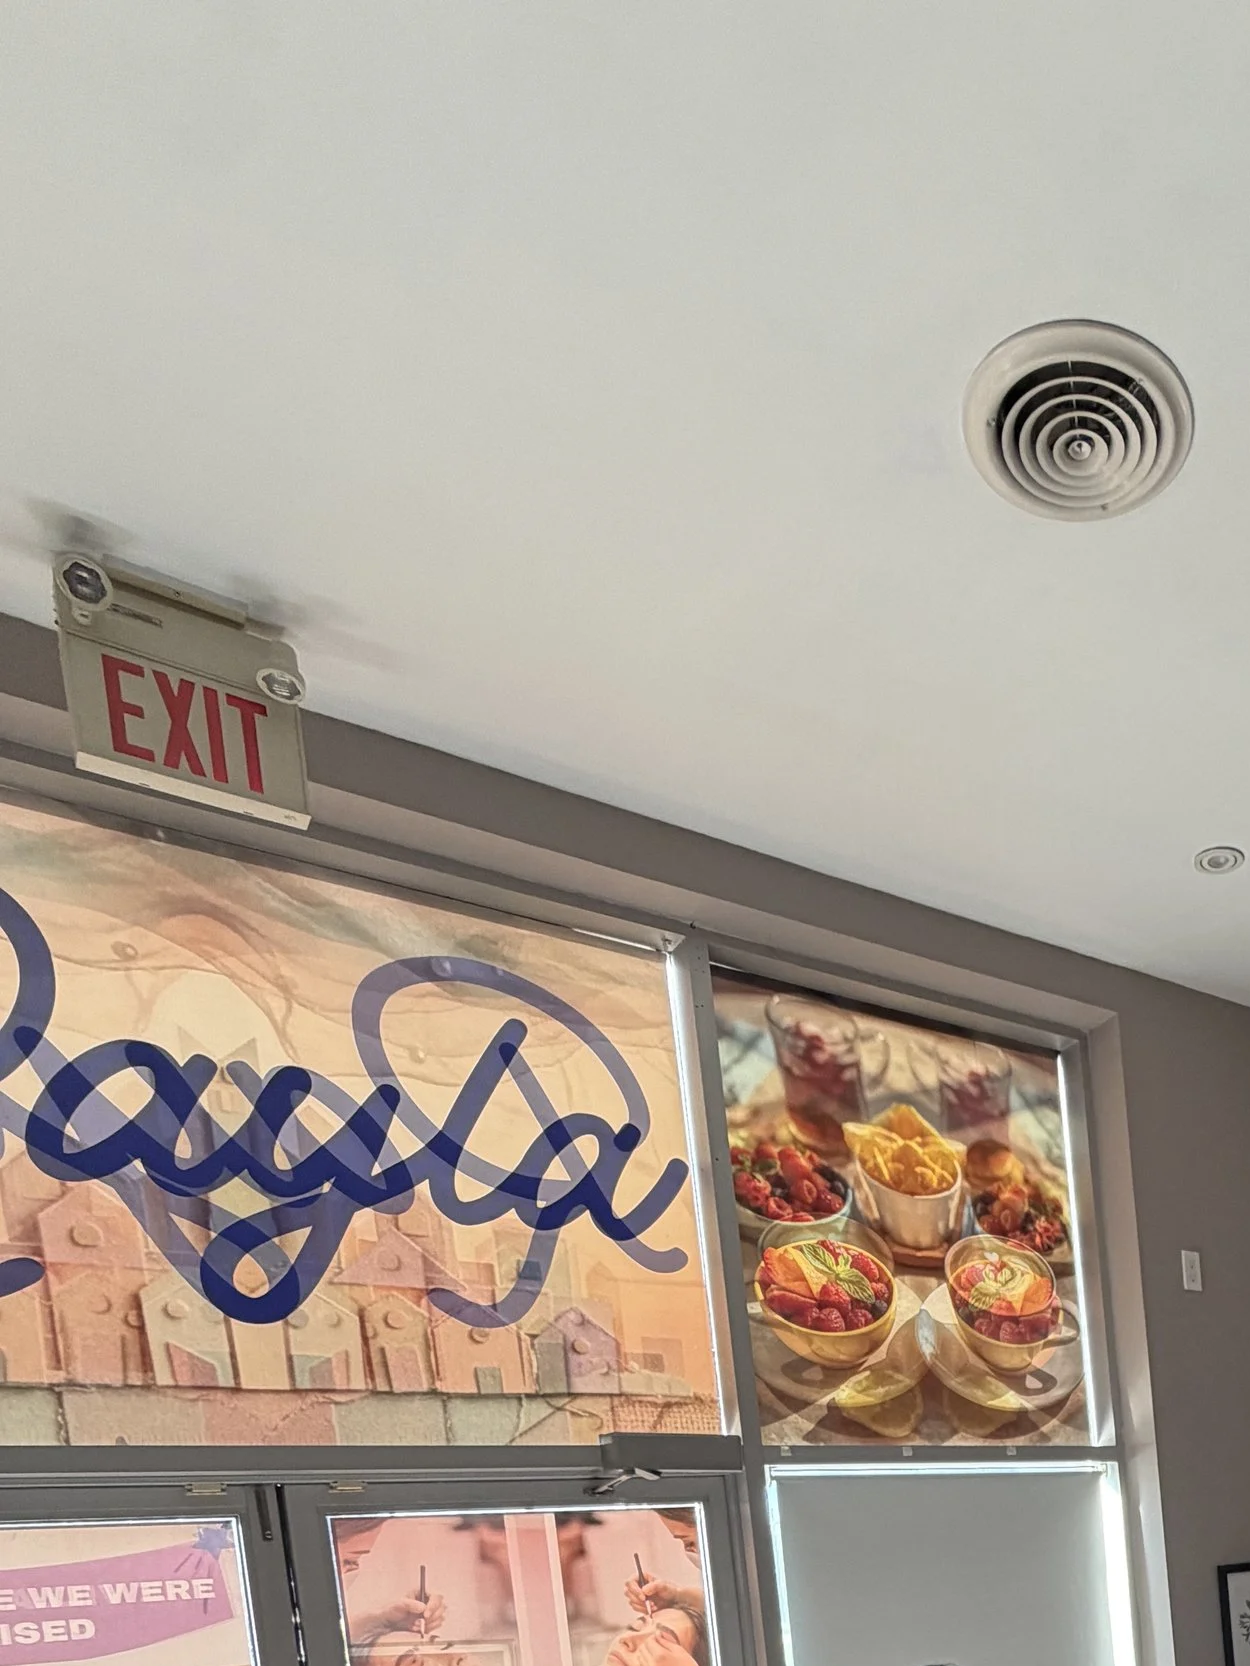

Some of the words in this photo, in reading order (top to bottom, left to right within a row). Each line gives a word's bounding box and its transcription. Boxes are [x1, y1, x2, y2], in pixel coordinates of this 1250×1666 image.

[102, 653, 268, 795] EXIT
[27, 1584, 94, 1609] WE
[103, 1577, 217, 1606] WERE
